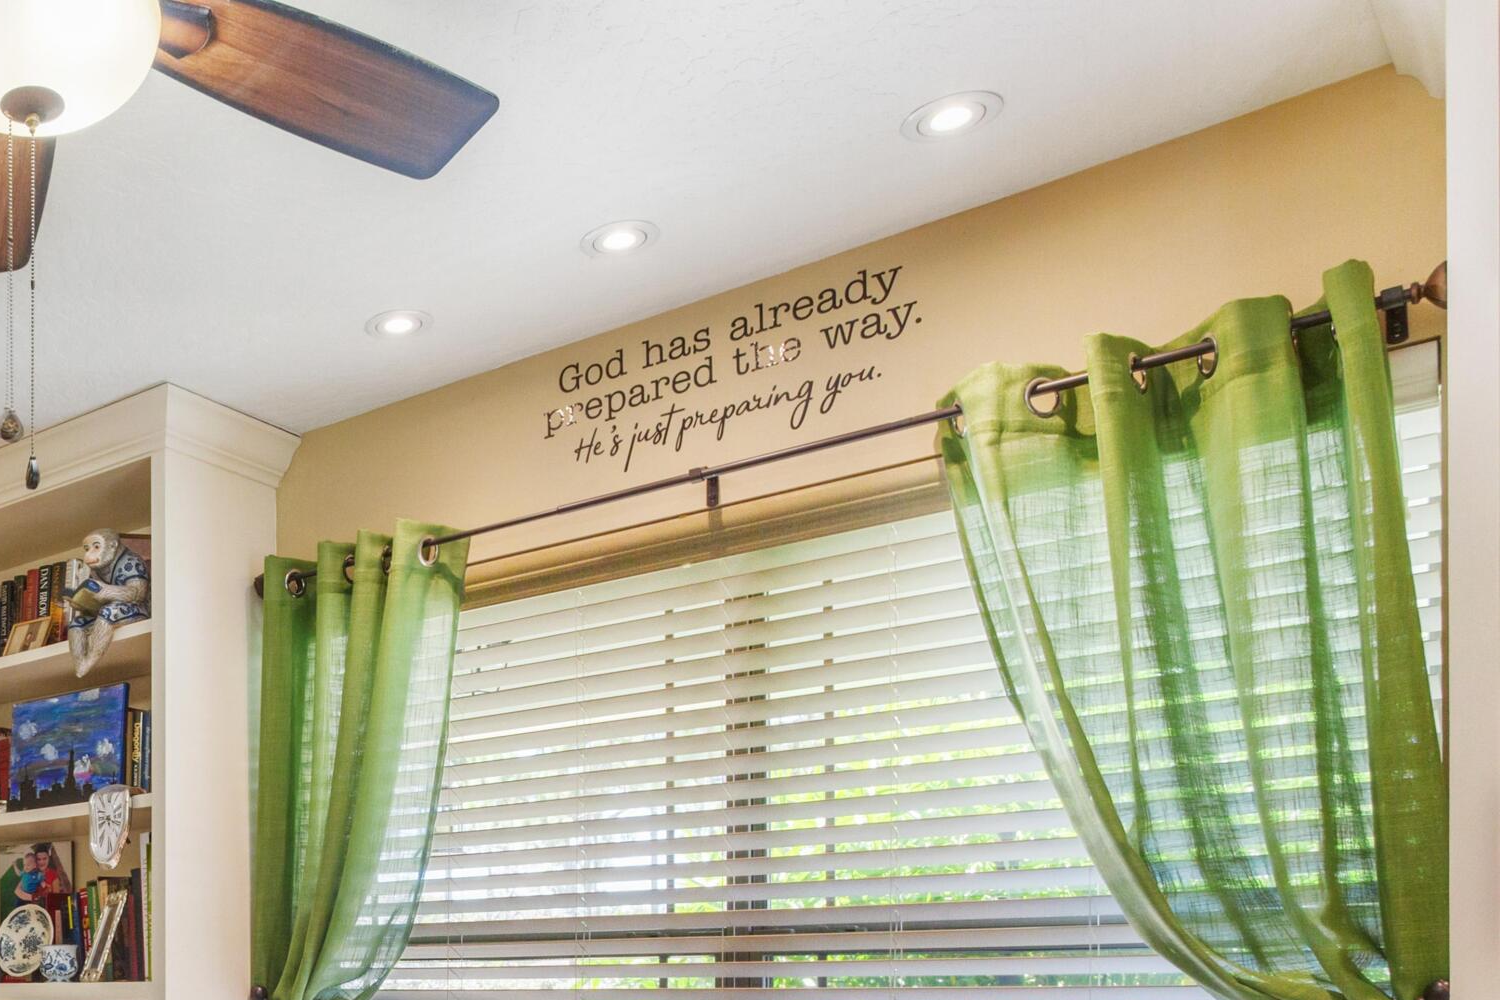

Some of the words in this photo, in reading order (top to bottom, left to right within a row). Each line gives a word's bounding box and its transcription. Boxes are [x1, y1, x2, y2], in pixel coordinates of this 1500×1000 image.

[543, 356, 717, 439] prepared
[733, 338, 801, 377] the
[820, 300, 923, 351] way.
[558, 348, 627, 393] God
[641, 326, 711, 369] has
[729, 265, 903, 342] already
[574, 425, 622, 464] He's
[624, 403, 685, 473] just
[676, 379, 814, 452] preparing
[820, 365, 883, 414] you.
[39, 591, 48, 617] BROW
[40, 567, 48, 590] DAN
